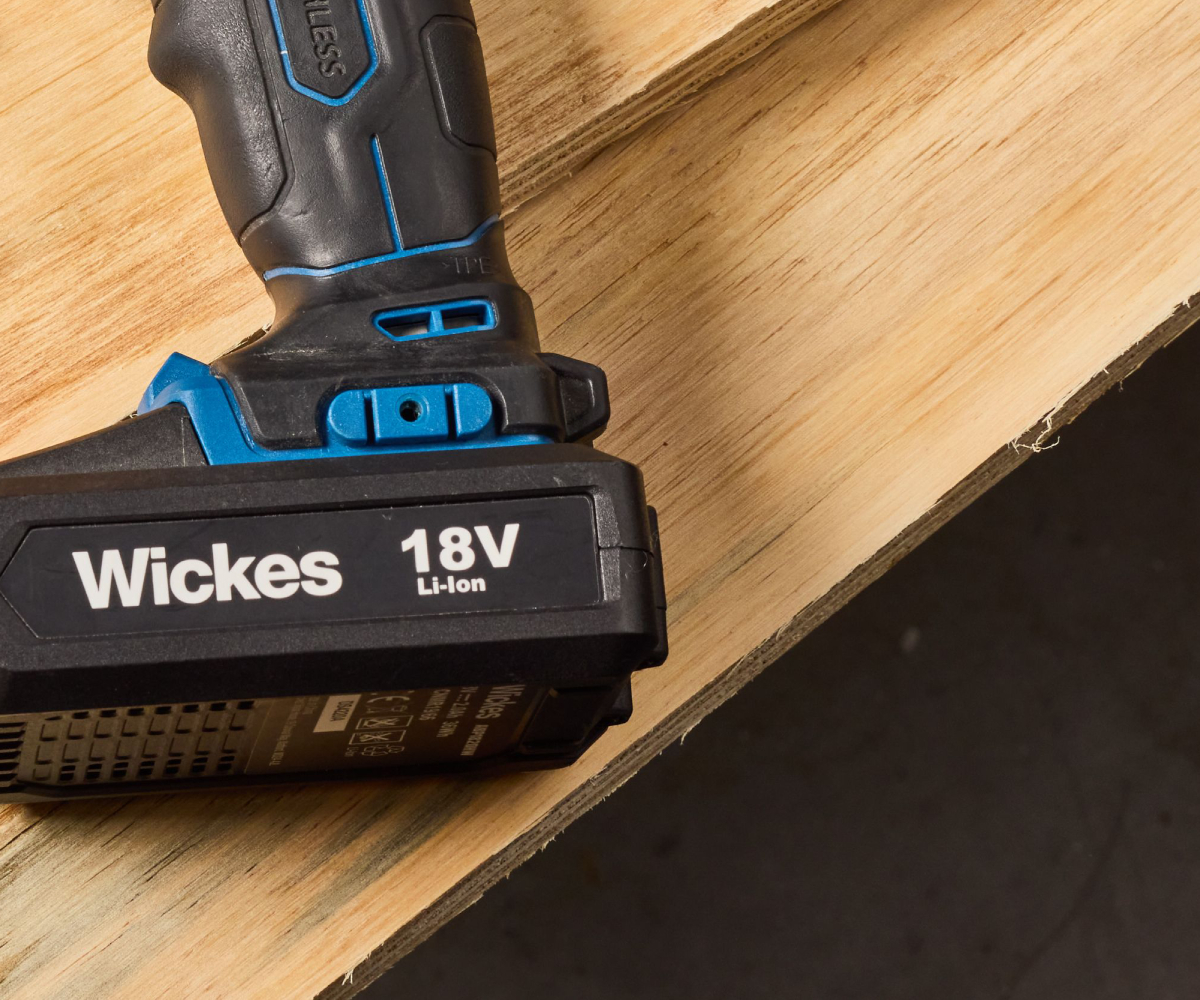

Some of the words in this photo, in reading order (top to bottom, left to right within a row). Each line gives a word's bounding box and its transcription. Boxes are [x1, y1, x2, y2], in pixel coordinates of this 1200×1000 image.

[71, 542, 343, 609] Wickes
[400, 523, 520, 573] 18V
[416, 574, 486, 596] Li-Ion
